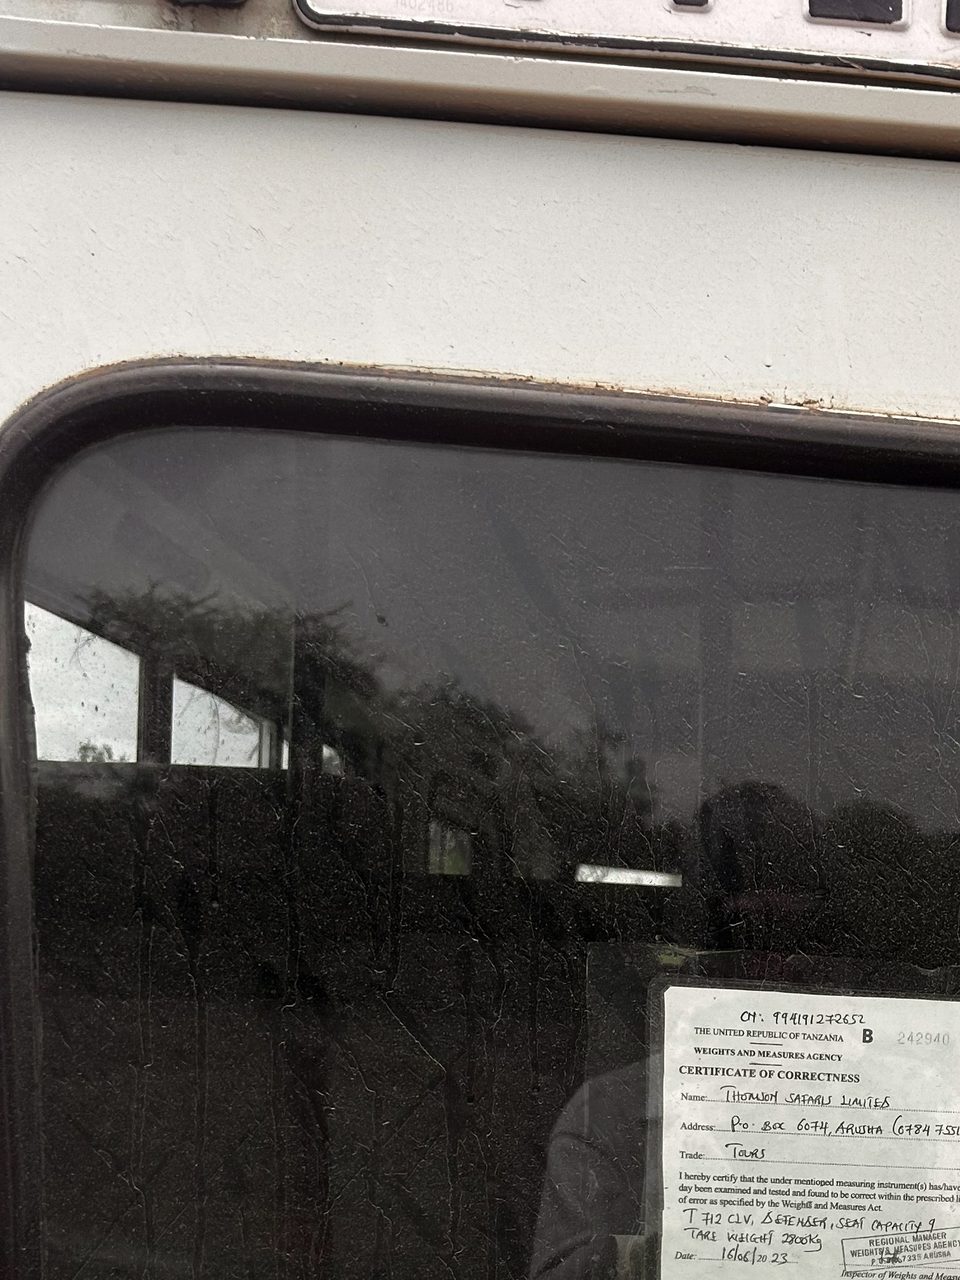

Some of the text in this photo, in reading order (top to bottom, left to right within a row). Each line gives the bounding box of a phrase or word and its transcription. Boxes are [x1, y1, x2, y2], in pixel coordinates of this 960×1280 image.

[694, 1027, 711, 1035] THE
[713, 1028, 744, 1037] UNITED
[746, 1030, 787, 1039] REPUBLIC
[801, 1033, 844, 1042] TANZANIA
[862, 1029, 950, 1045] B 242940
[694, 1047, 735, 1056] WEIGHTS
[757, 1051, 805, 1059] MEASURES
[679, 1065, 860, 1083] CERTIFICATE OF CORRECTNESS
[681, 1092, 707, 1101] Name:
[680, 1122, 716, 1131] Address:
[680, 1151, 705, 1159] Trade:
[684, 1172, 711, 1182] hereby
[713, 1175, 738, 1183] certify
[756, 1176, 768, 1184] the
[836, 1180, 875, 1190] measuring
[877, 1182, 927, 1191] instrument(s)
[929, 1183, 960, 1191] has/have
[679, 1184, 693, 1193] day
[714, 1187, 751, 1195] examined
[807, 1189, 829, 1198] found
[840, 1191, 849, 1199] be
[916, 1195, 954, 1203] prescribed
[720, 1198, 754, 1207] specified
[756, 1200, 766, 1208] by
[830, 1202, 866, 1211] Measures
[702, 1213, 721, 1226] 712
[869, 1232, 946, 1247] REGIONAL MANAGER
[675, 1252, 697, 1260] Date:
[841, 1270, 876, 1279] Inspector
[878, 1271, 886, 1280] of
[888, 1271, 917, 1280] Weights
